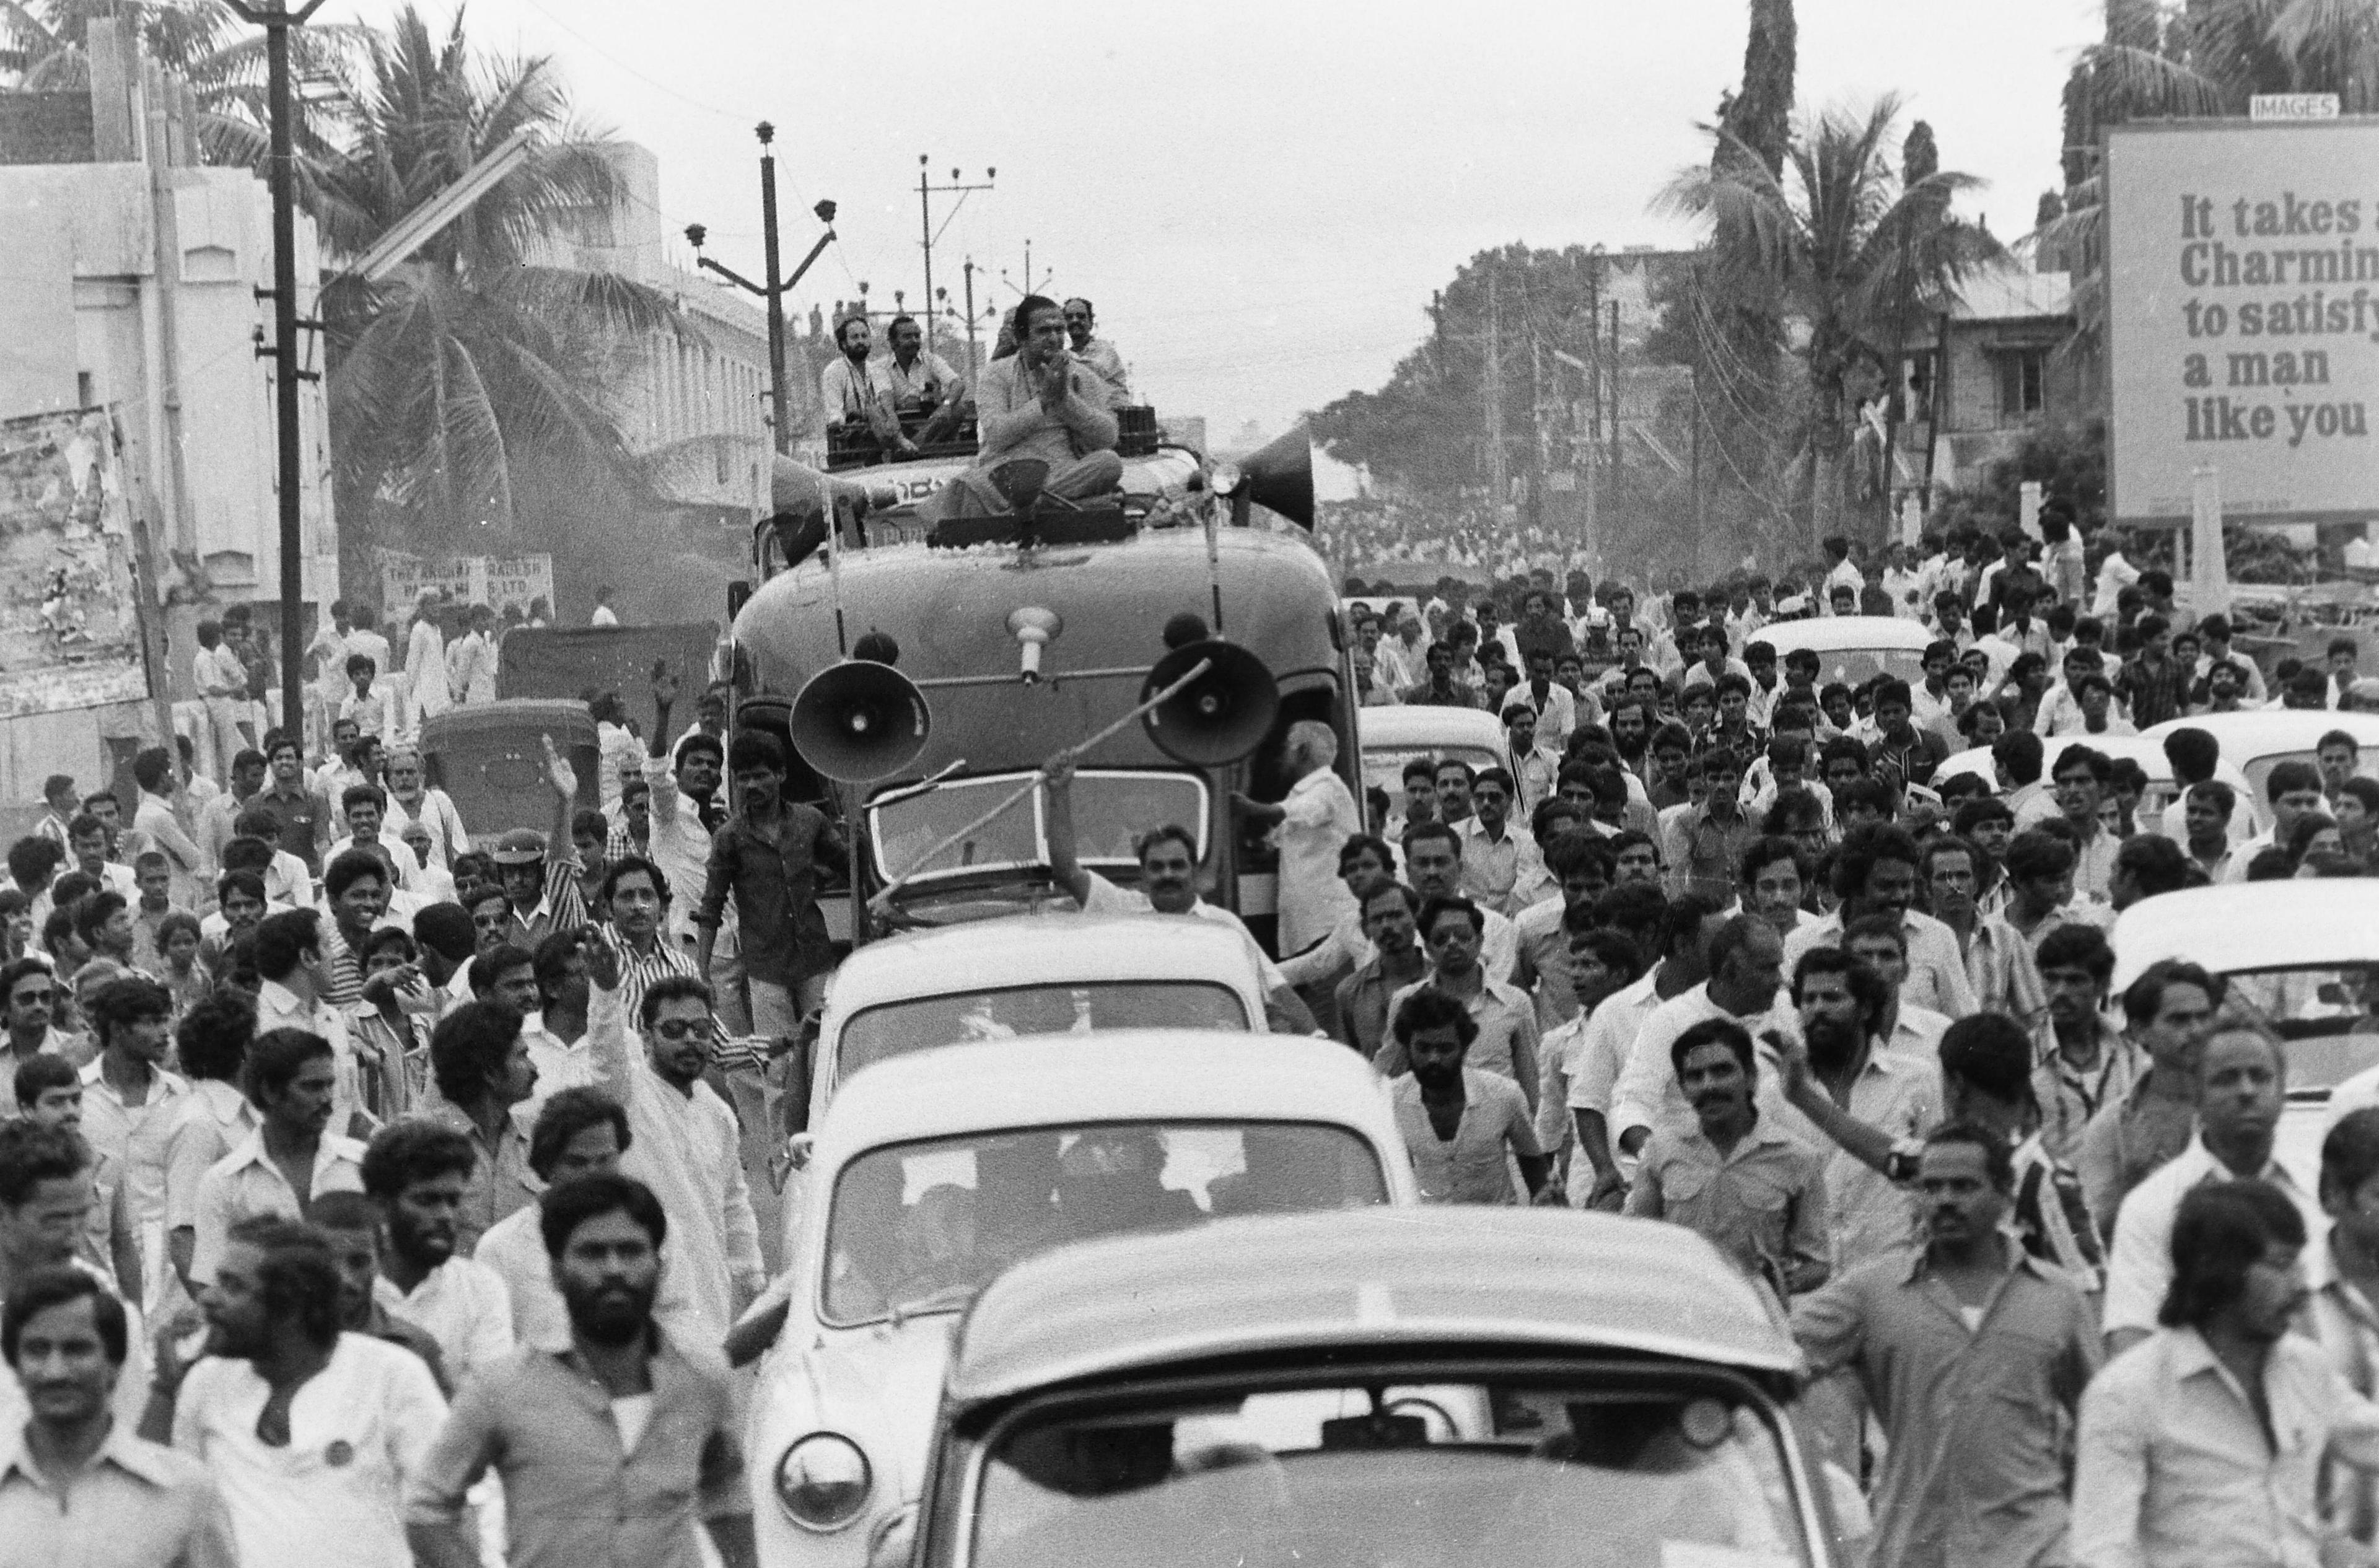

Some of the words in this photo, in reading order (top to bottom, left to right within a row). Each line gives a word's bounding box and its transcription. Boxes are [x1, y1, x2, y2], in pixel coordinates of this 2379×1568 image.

[2255, 97, 2334, 117] IMAGES
[2181, 195, 2215, 239] It
[2232, 191, 2360, 237] takes
[2181, 238, 2379, 286] Charmin
[2182, 297, 2228, 338] to
[2184, 353, 2212, 388] a
[2227, 350, 2330, 387] man
[2184, 396, 2275, 441] like
[2284, 402, 2368, 448] you
[487, 562, 541, 577] RADESH
